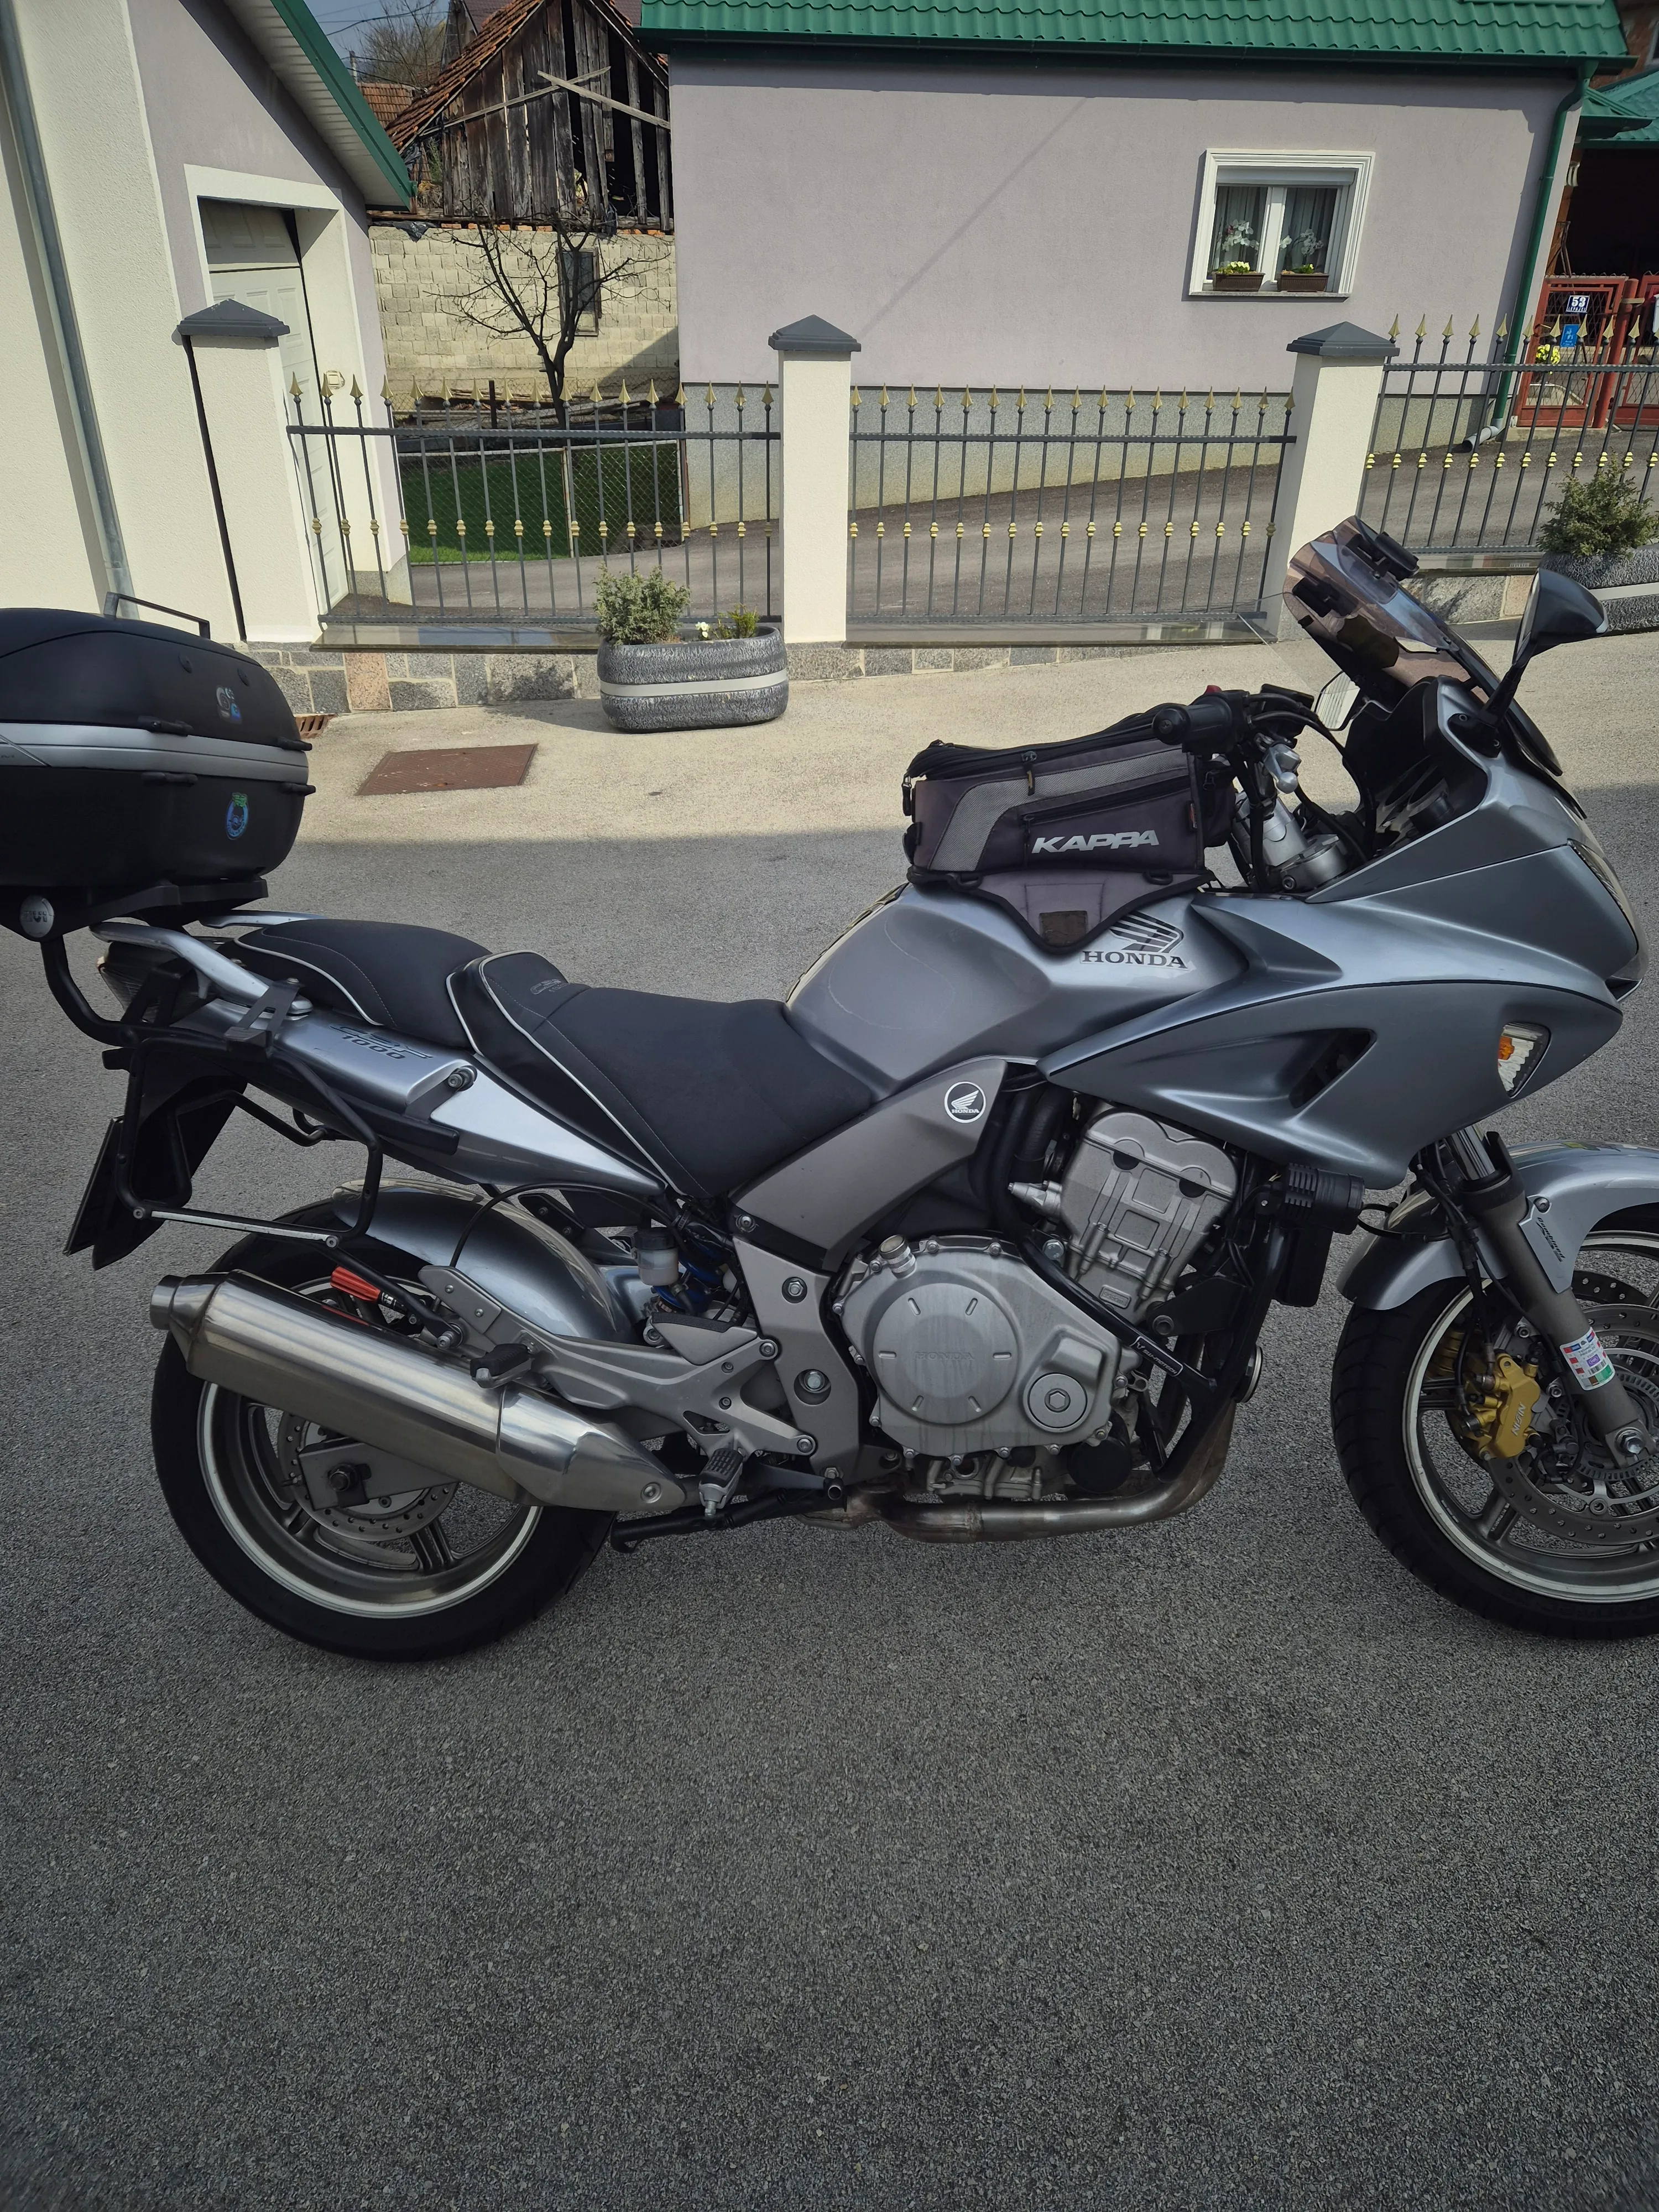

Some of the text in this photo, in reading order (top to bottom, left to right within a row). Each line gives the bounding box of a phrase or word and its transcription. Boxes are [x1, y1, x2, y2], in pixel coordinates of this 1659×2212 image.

[1572, 296, 1586, 307] 53
[1031, 830, 1159, 853] KAPPA
[1082, 951, 1188, 969] HONDA
[341, 1035, 406, 1059] 1000
[1142, 1349, 1177, 1374] SW-MOTECH
